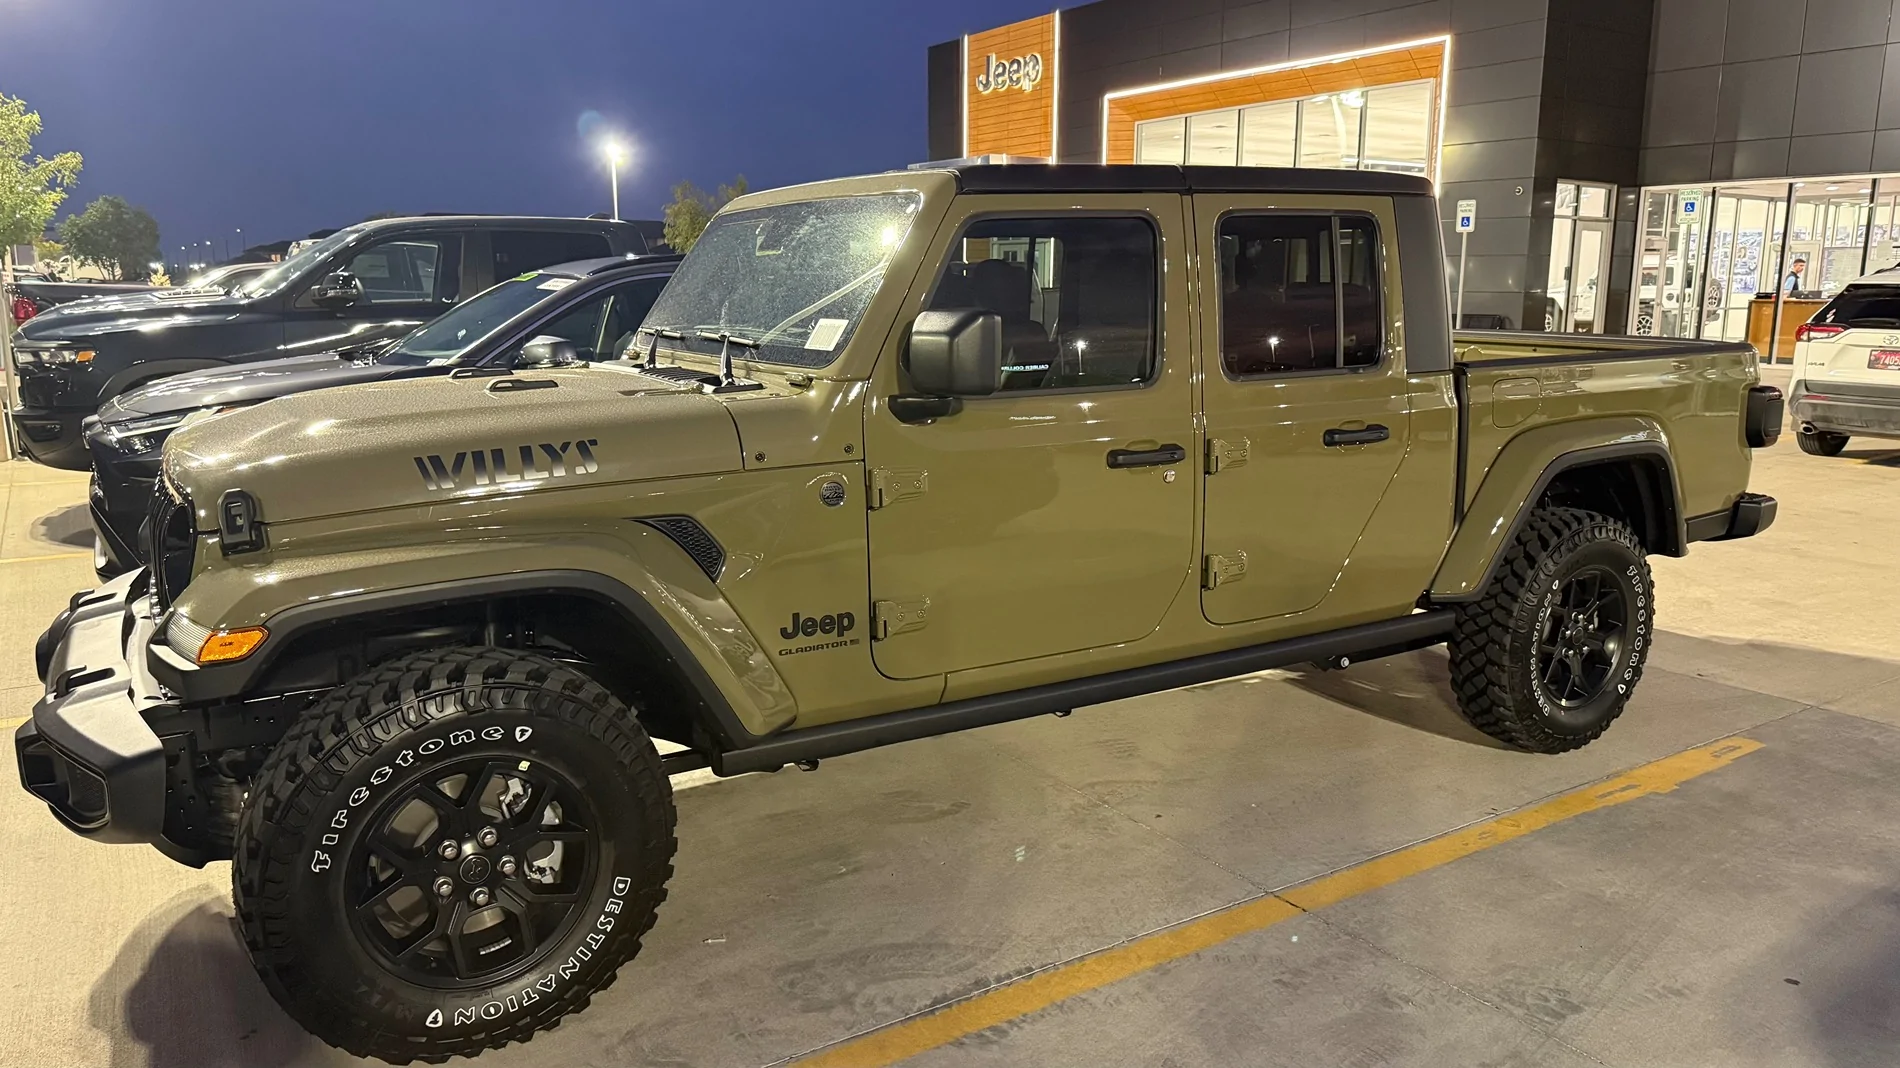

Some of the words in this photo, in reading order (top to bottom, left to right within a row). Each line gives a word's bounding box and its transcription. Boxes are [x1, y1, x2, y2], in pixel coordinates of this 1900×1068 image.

[976, 52, 1042, 94] Jeep
[1879, 354, 1900, 365] 7405
[413, 439, 598, 491] WILLYS
[780, 611, 855, 640] Jeep
[778, 640, 848, 657] GLADIATOR
[454, 876, 631, 1026] DESTINATION
